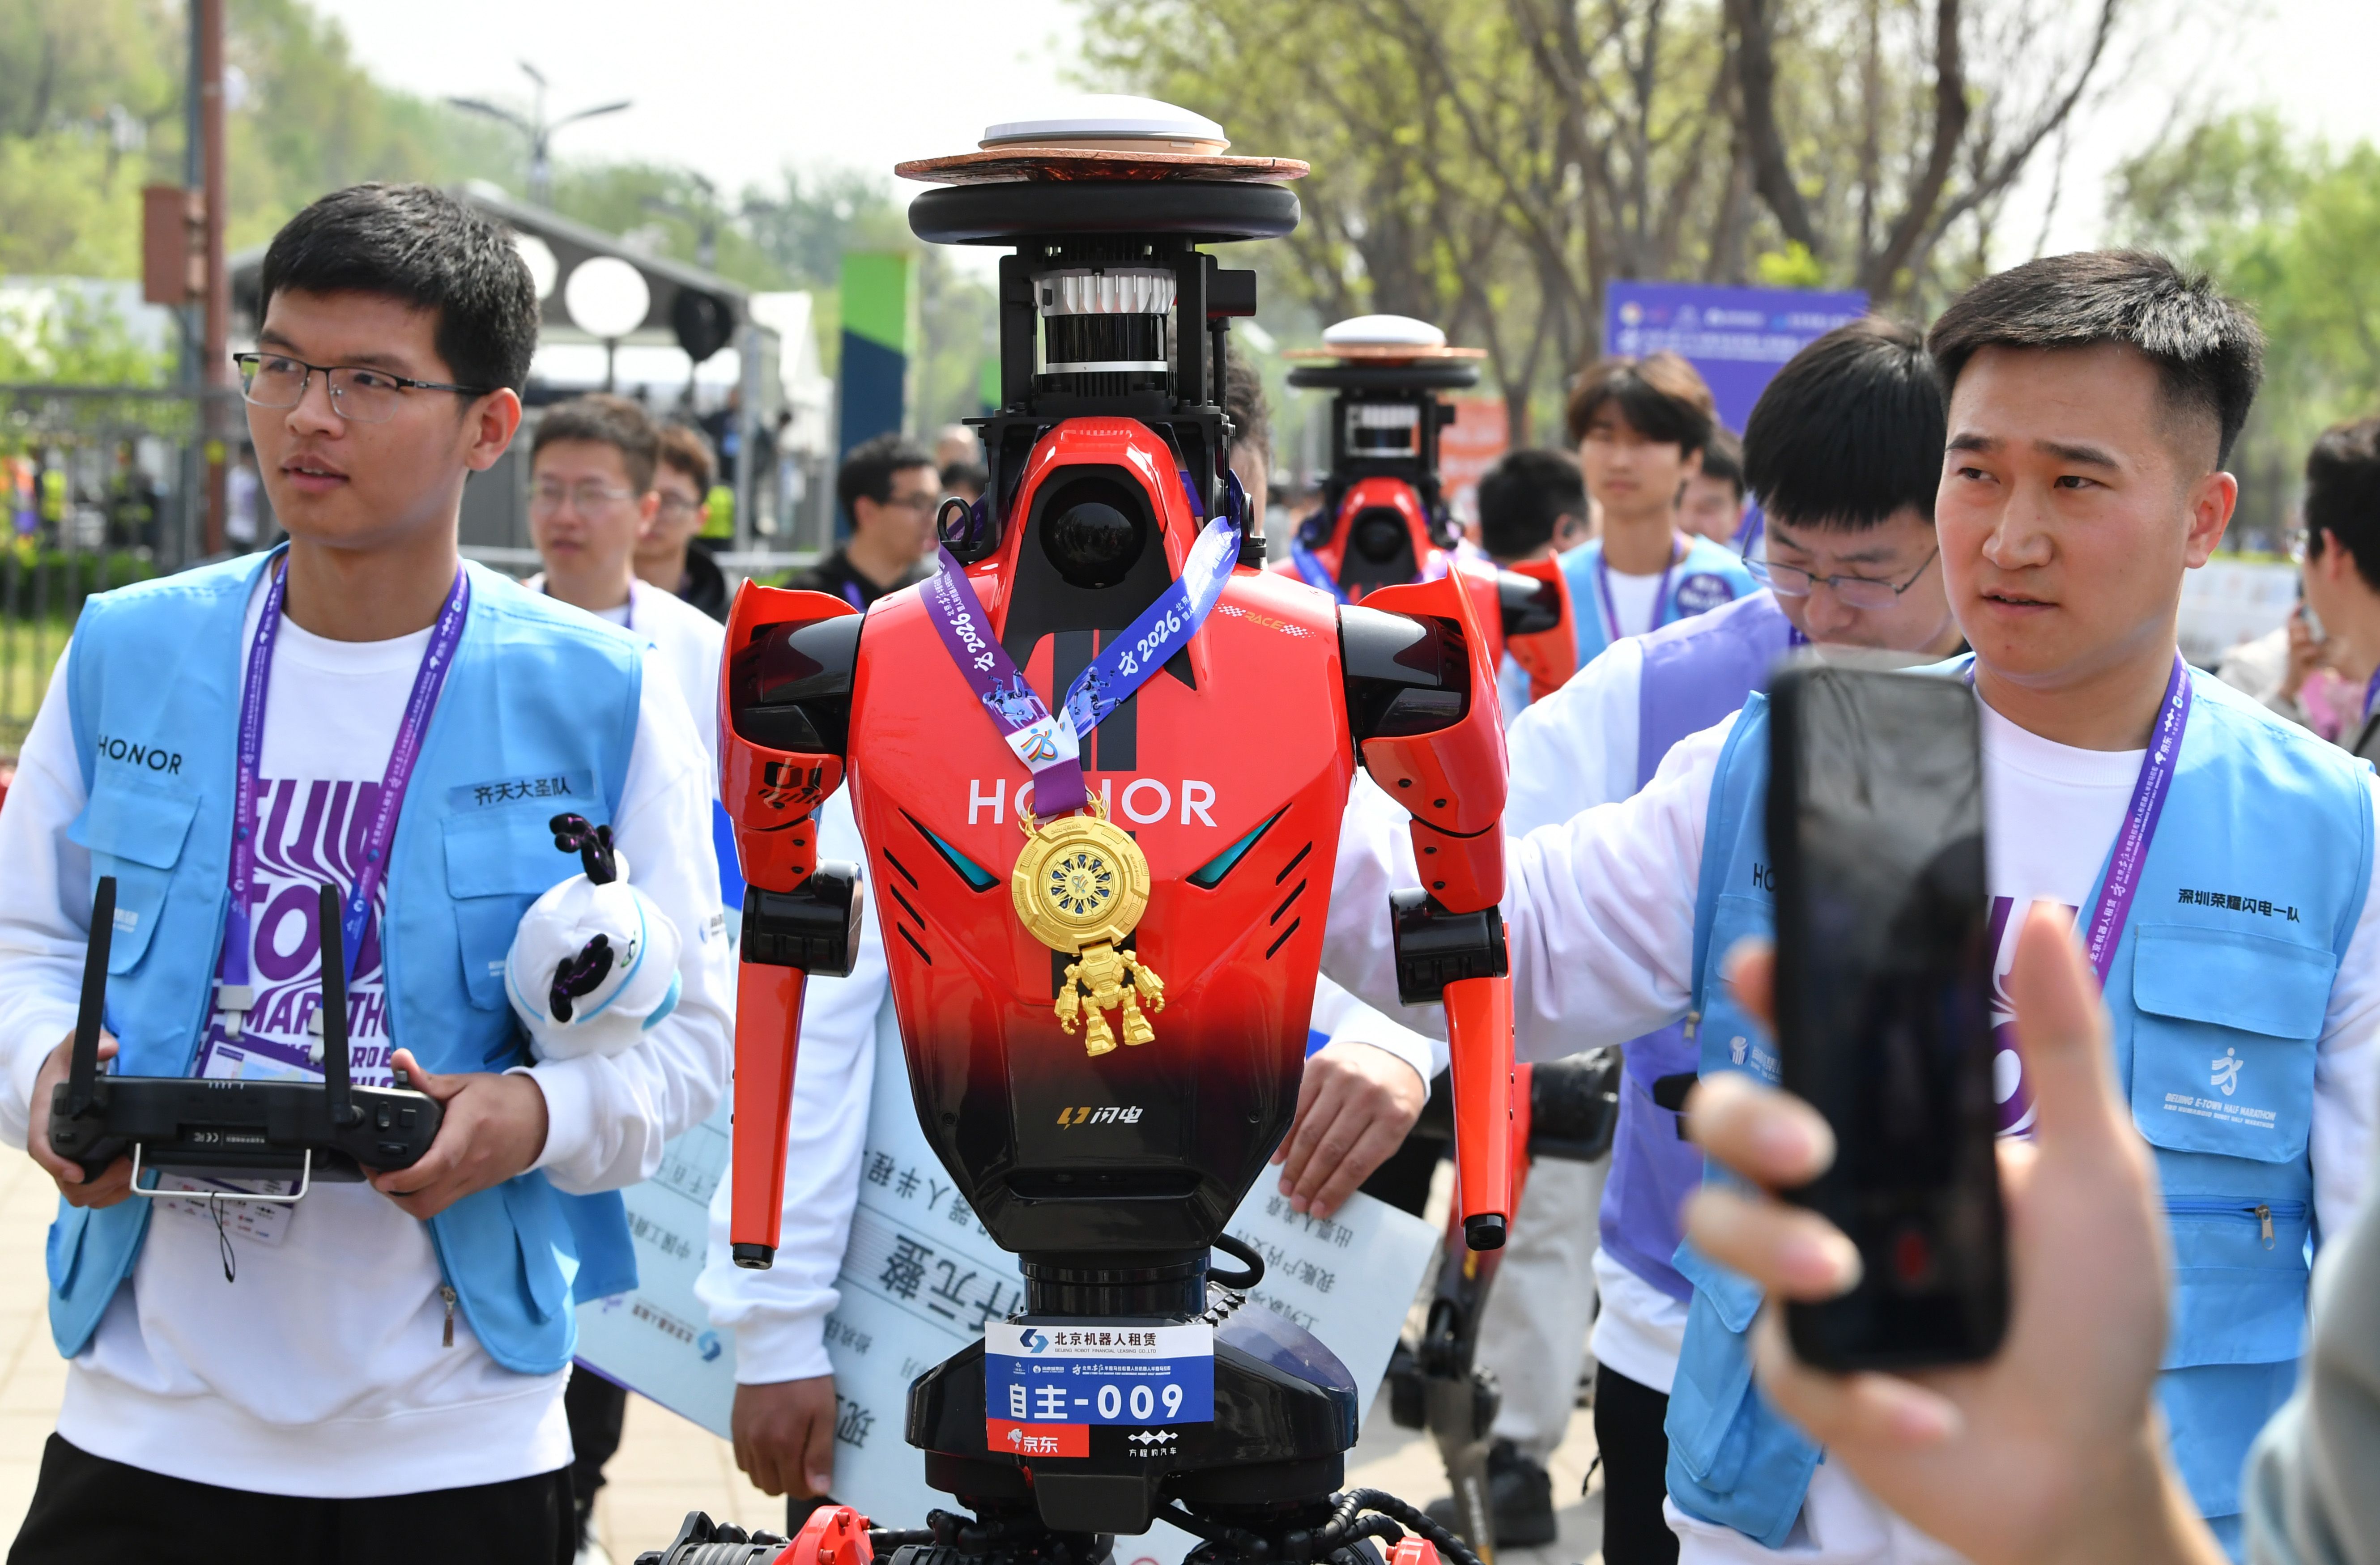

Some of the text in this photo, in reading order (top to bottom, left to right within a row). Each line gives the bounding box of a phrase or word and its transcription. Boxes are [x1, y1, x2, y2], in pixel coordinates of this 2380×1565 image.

[951, 613, 985, 652] 2026
[1244, 611, 1286, 630] RACE
[1137, 611, 1180, 661] 2026
[98, 735, 183, 775] HONOR
[2161, 736, 2172, 753] 京东
[475, 777, 571, 805] 齐天大圣队
[2178, 888, 2301, 923] 深圳荣耀闪电一队
[2087, 900, 2116, 961] 北京机器人租赁
[242, 992, 388, 1038] MARTH
[1090, 1106, 1143, 1123] 闪电
[2165, 1093, 2276, 1121] BEIJING E-TOWN HALF MARATHON
[1055, 1332, 1156, 1346] 北京机器人租赁
[1009, 1383, 1183, 1419] 自主-009
[1023, 1436, 1058, 1453] 京东
[1129, 1447, 1176, 1457] 方程豹汽车
